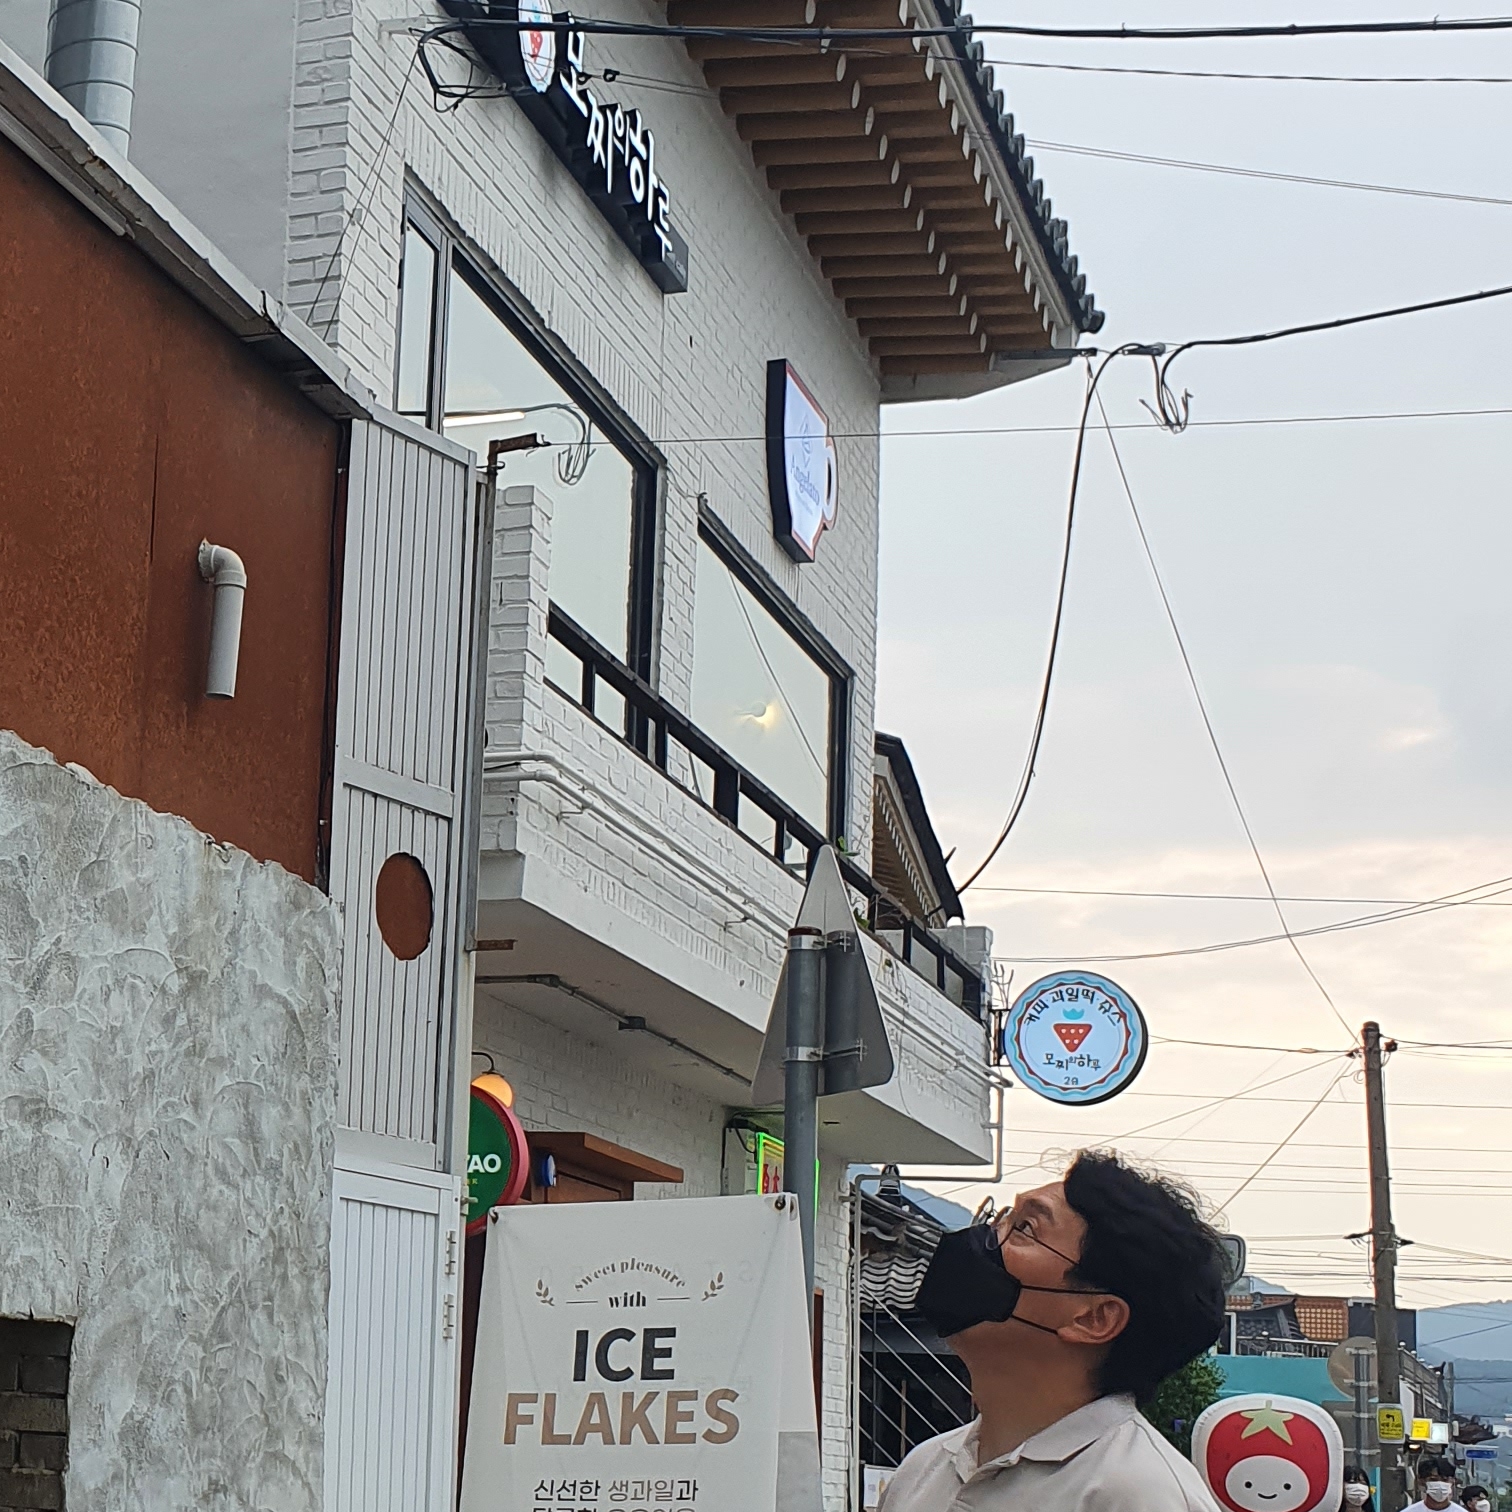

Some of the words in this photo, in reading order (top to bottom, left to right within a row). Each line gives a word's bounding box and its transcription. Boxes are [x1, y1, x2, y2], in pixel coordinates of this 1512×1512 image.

[467, 1153, 502, 1174] AO
[575, 1263, 616, 1292] sweet
[620, 1257, 686, 1288] pleasure
[608, 1291, 647, 1308] with
[573, 1327, 677, 1382] ICE
[503, 1388, 740, 1446] FLAKES
[533, 1479, 601, 1502] 신선한
[607, 1479, 699, 1503] 생과일과
